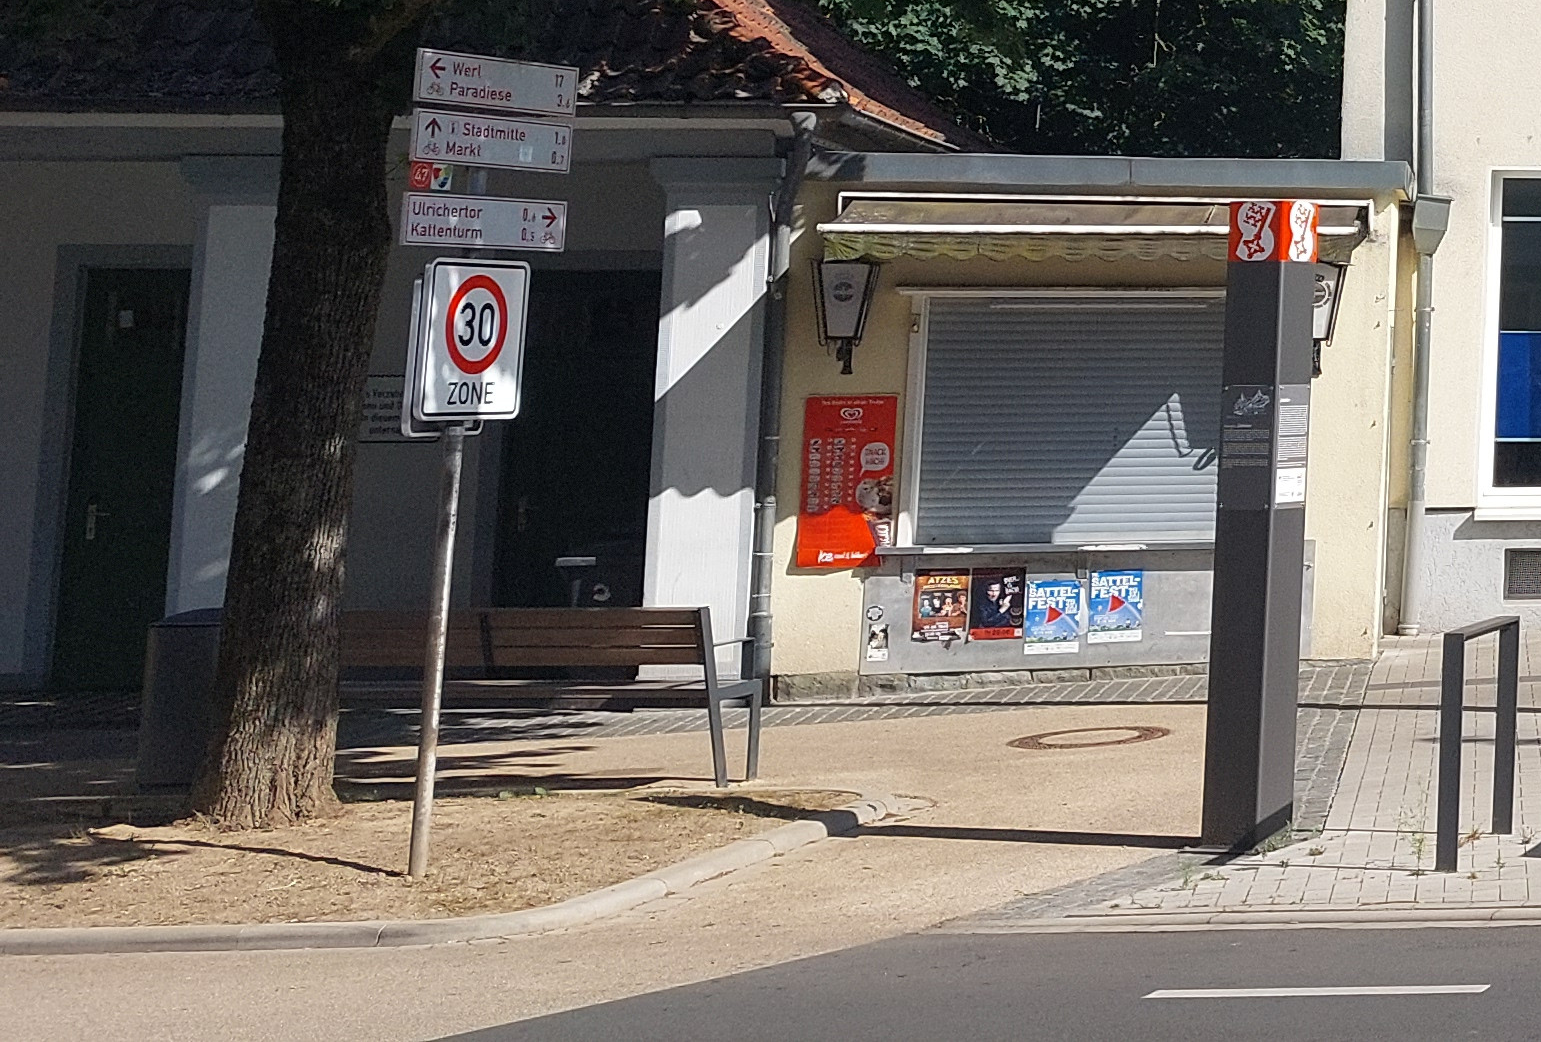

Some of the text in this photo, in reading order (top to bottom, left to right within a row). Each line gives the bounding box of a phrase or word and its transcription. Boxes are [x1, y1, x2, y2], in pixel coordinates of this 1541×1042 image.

[453, 62, 564, 89] Werl 17
[449, 82, 512, 102] Paradiese
[462, 122, 526, 142] Stadtmitte
[445, 142, 482, 158] Markt
[412, 202, 483, 219] Ulrichertor
[411, 222, 483, 239] Kattenturm
[458, 301, 495, 347] 30
[446, 381, 495, 405] ZONE
[928, 576, 959, 585] ATZES
[1092, 575, 1141, 587] SATTEL-
[1028, 587, 1078, 598] SATTEL-
[1091, 585, 1129, 599] FEST
[1028, 596, 1065, 609] FEST
